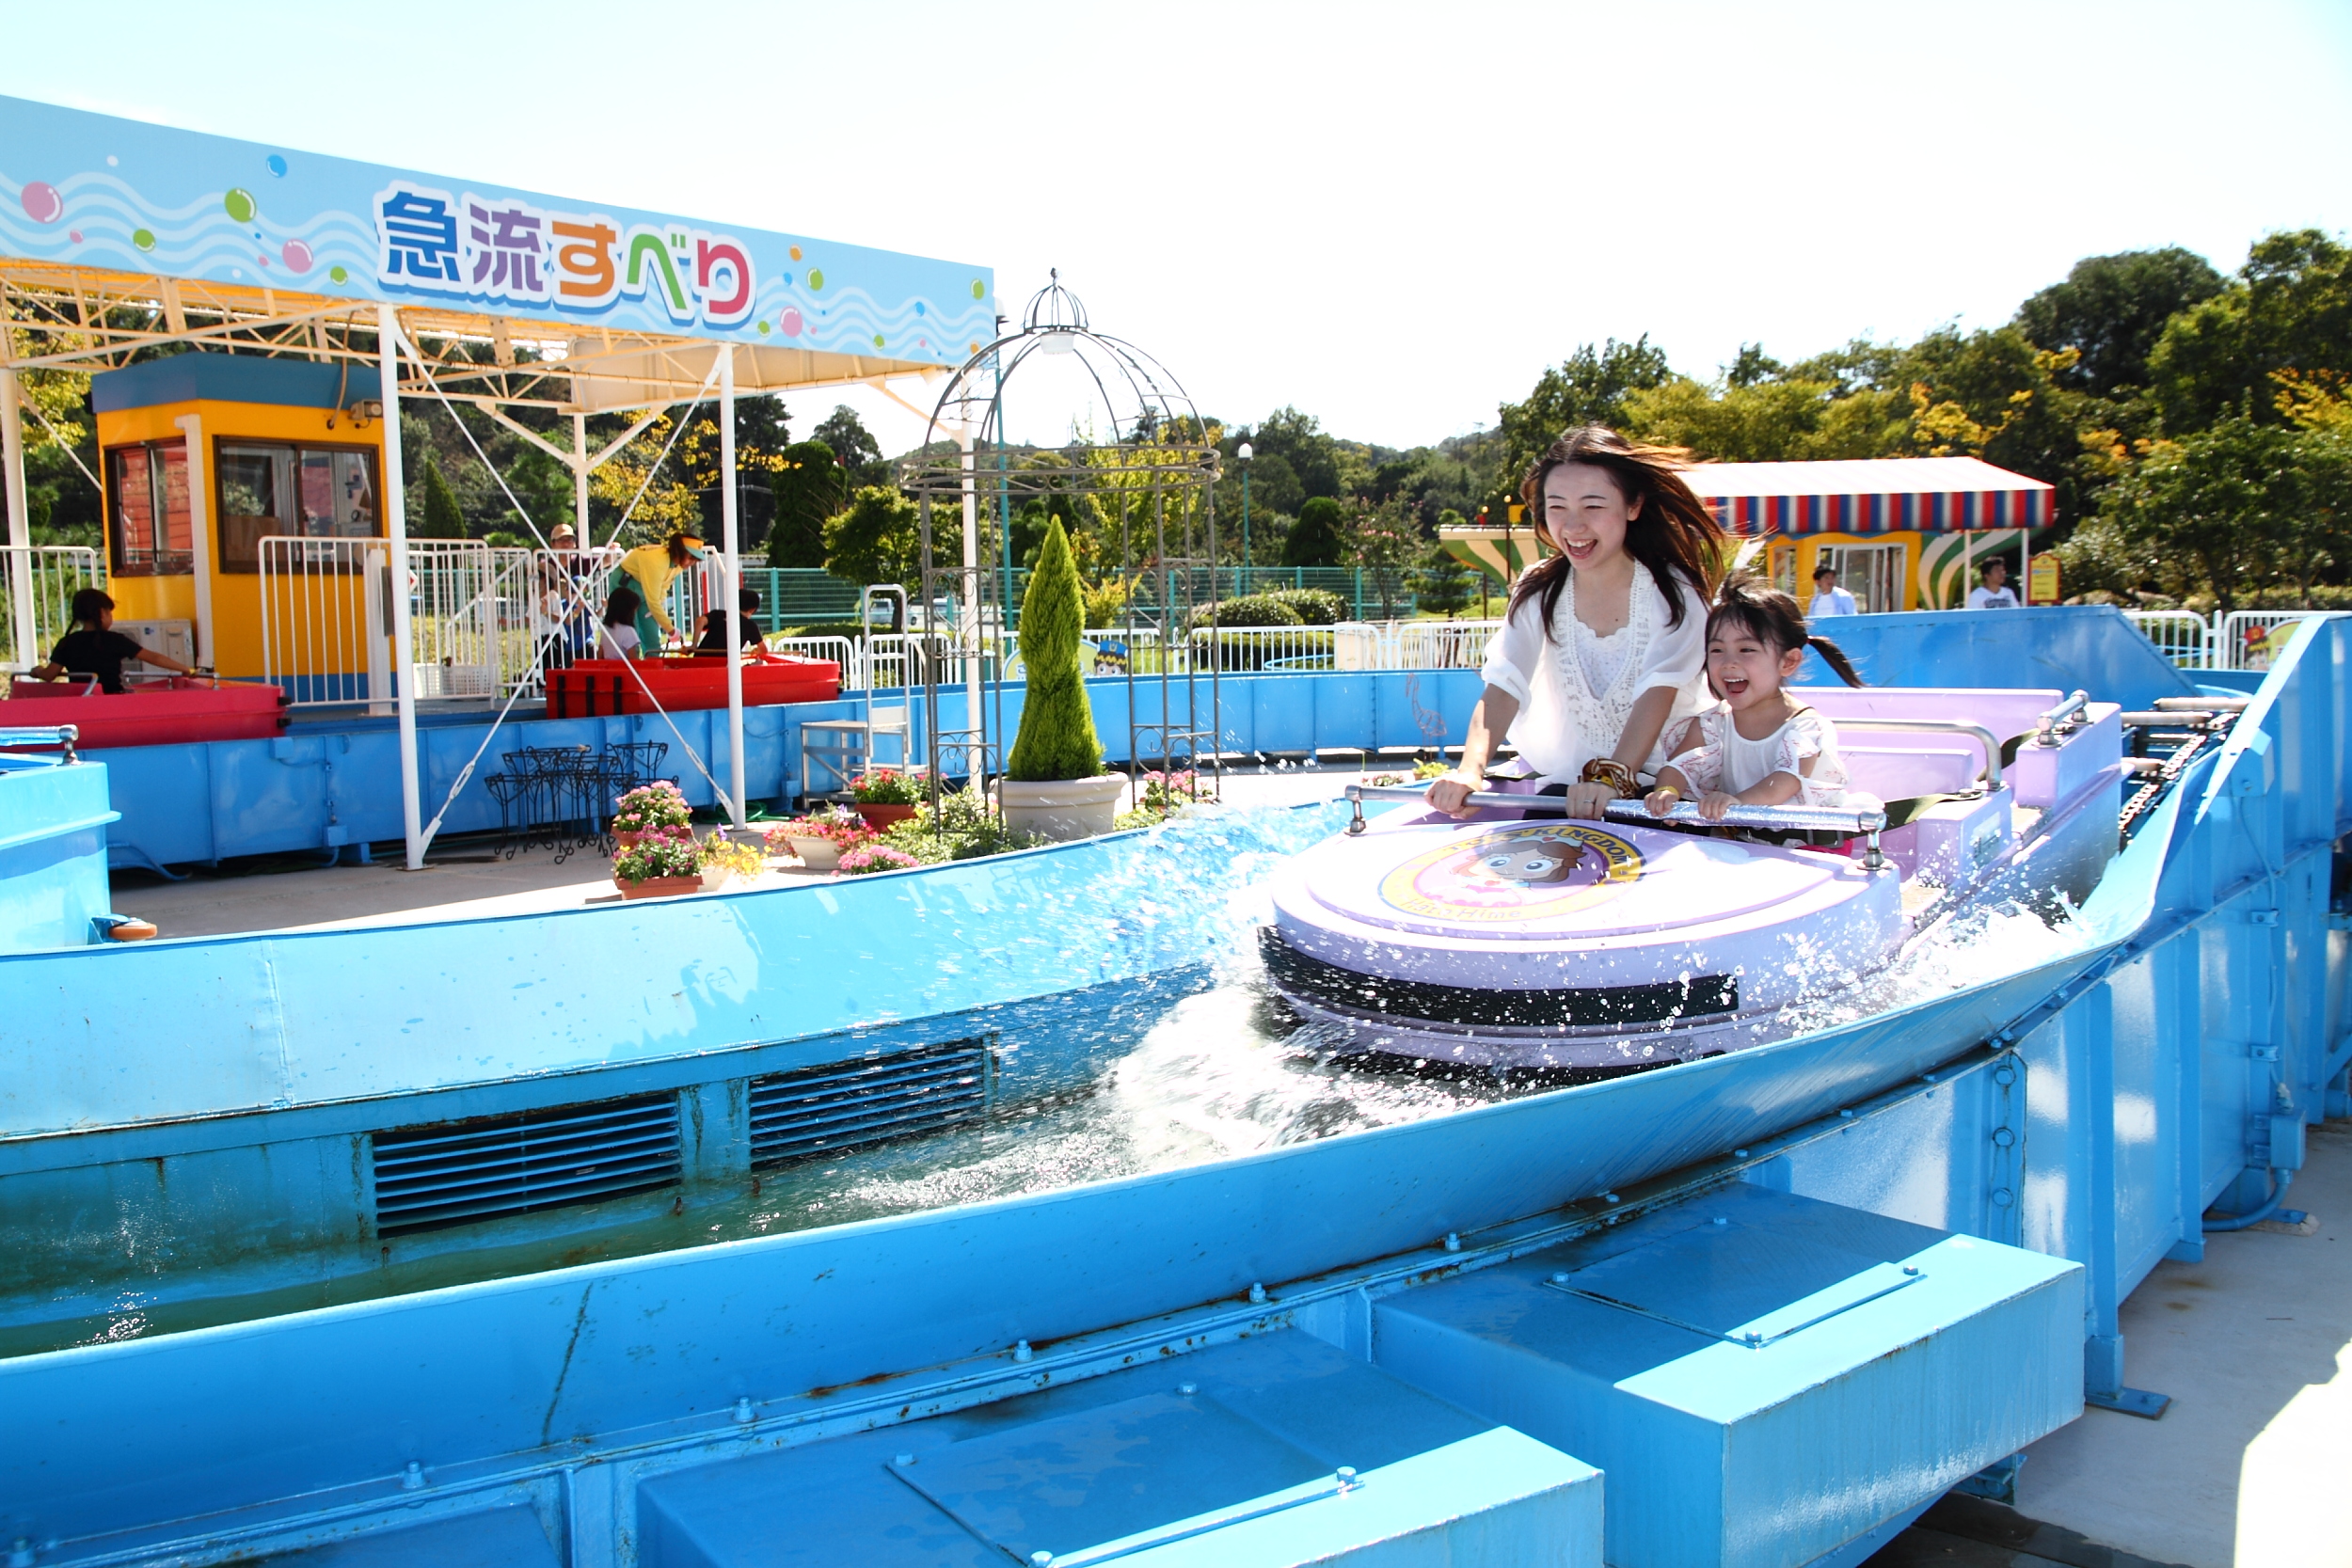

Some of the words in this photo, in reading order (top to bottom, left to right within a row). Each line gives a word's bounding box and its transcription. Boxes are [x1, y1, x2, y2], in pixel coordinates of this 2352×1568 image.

[381, 189, 752, 317] 急流すべり
[1530, 828, 1630, 864] KINGDOM
[1456, 908, 1520, 919] Hime
